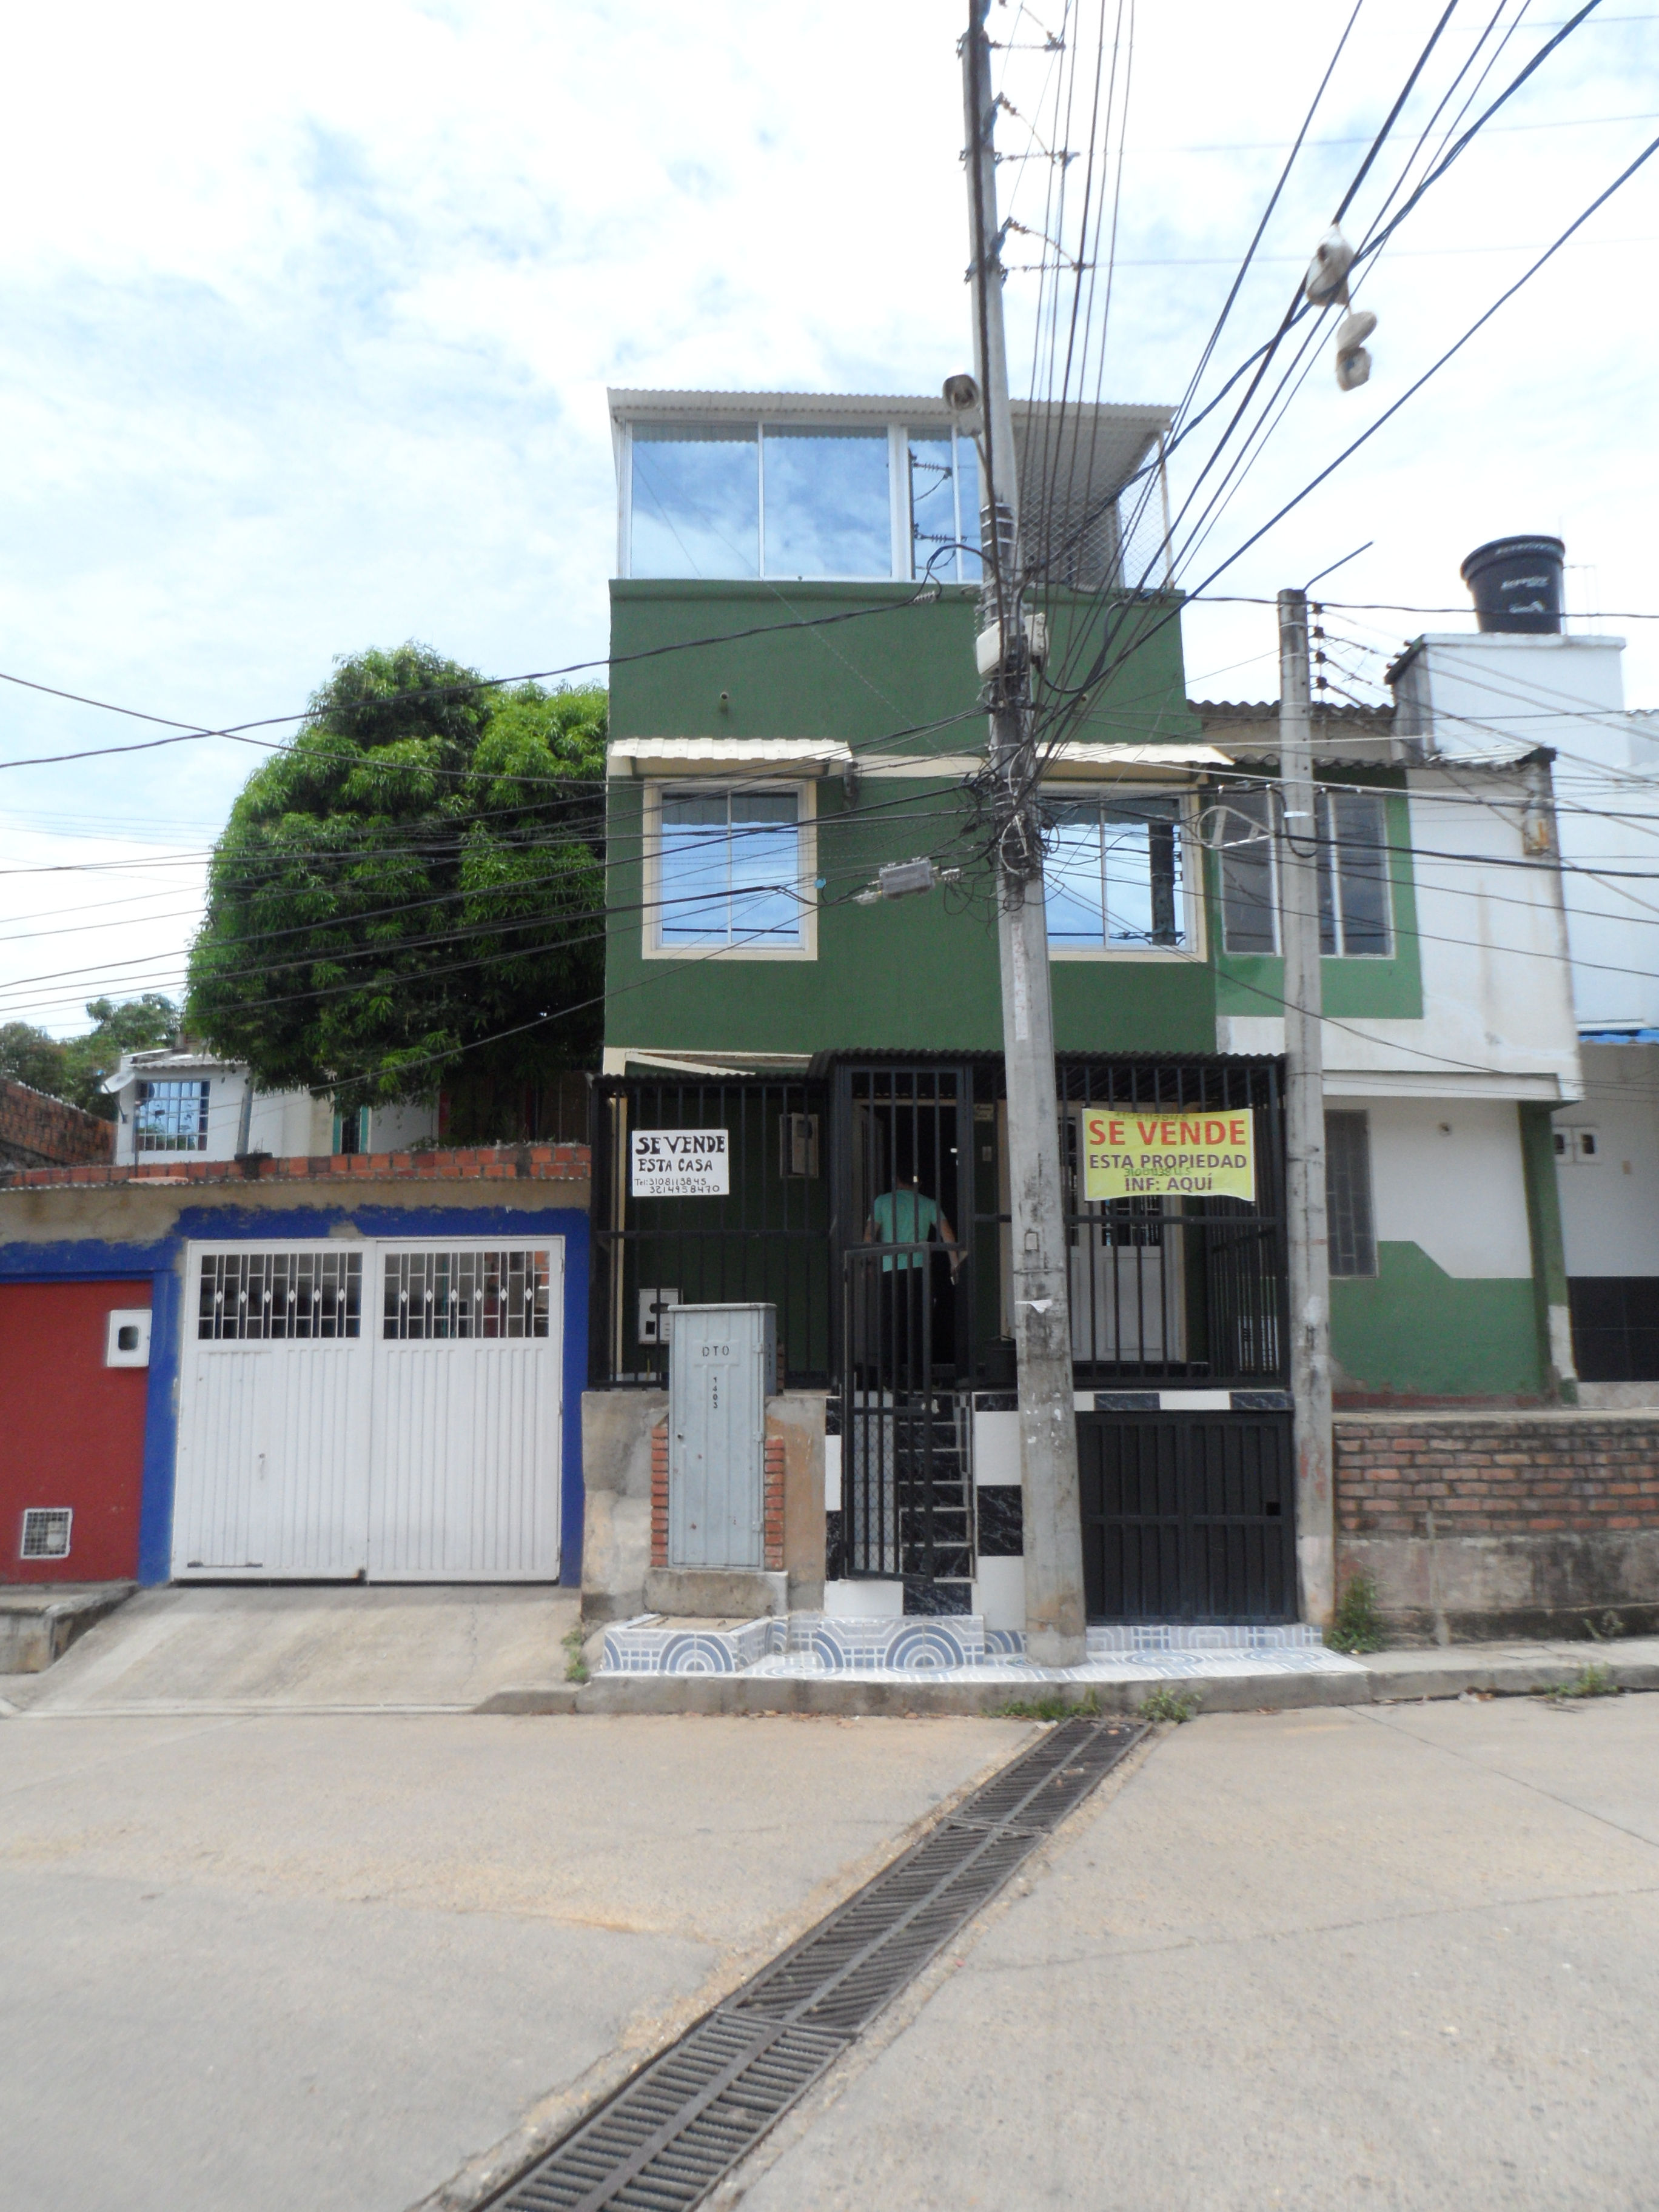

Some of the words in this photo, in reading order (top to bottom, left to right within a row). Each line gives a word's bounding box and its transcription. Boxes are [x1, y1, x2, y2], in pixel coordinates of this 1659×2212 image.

[1089, 1119, 1125, 1145] SE
[1137, 1120, 1246, 1145] VENDE
[635, 1137, 661, 1155] SE
[663, 1136, 725, 1155] VENDE
[638, 1159, 672, 1172] ESTA
[678, 1158, 712, 1172] CASA
[1090, 1155, 1134, 1168] ESTA
[1141, 1154, 1247, 1168] PROPIEDAD
[1125, 1178, 1160, 1191] INF:
[1167, 1173, 1213, 1192] AQUÍ
[702, 1346, 729, 1356] DTO
